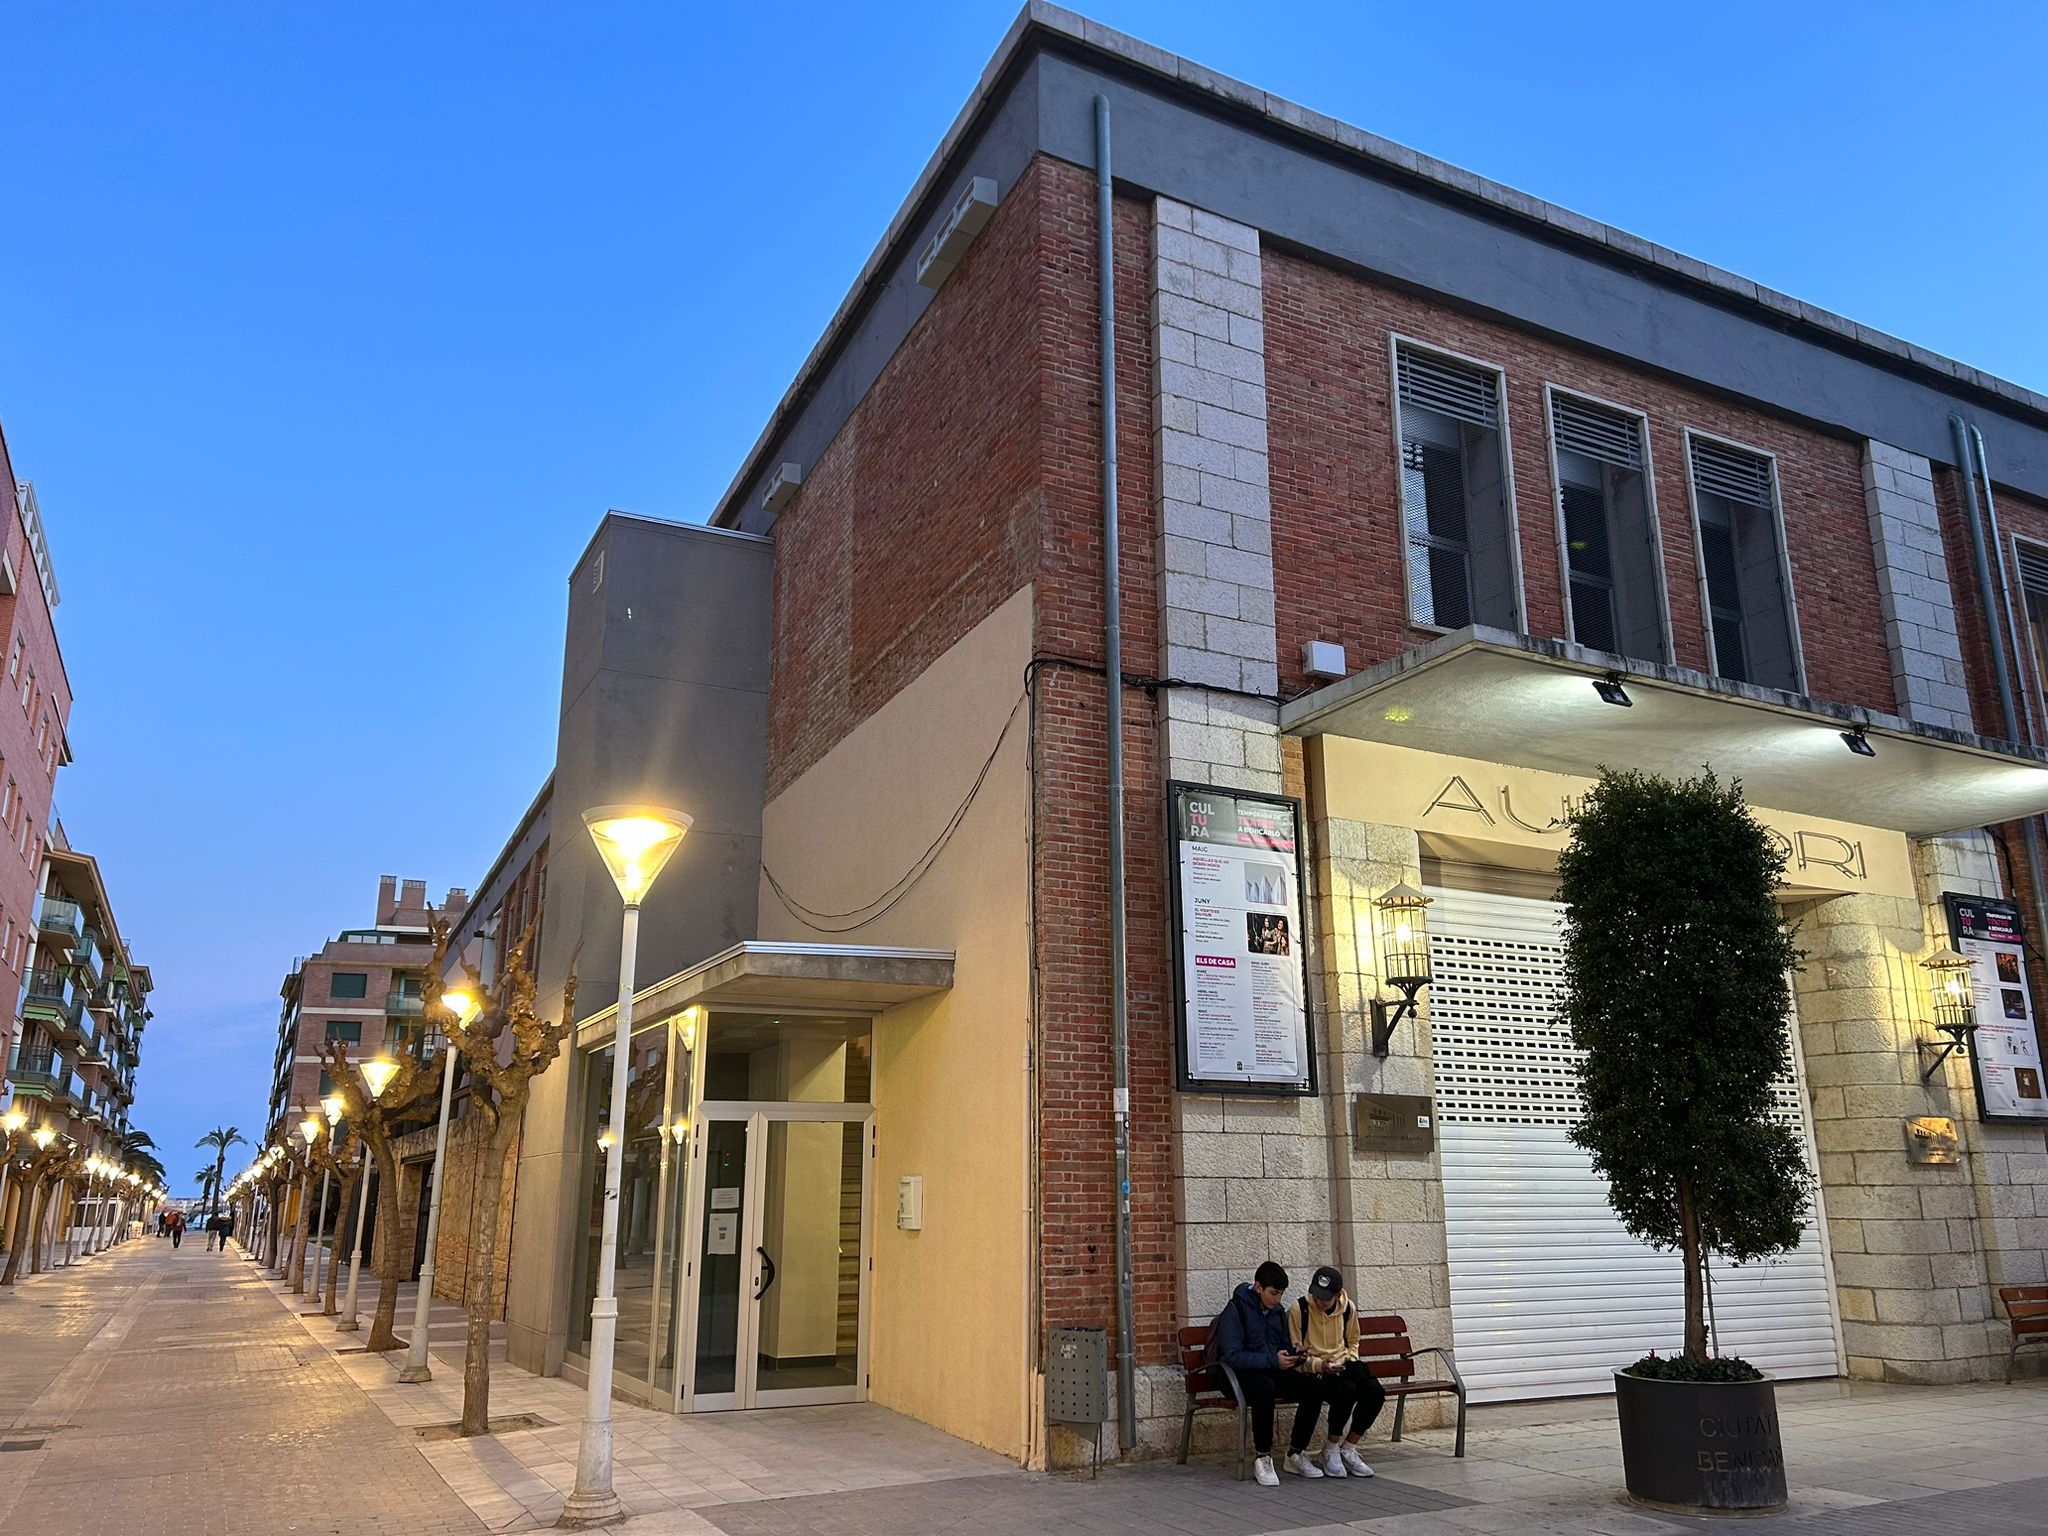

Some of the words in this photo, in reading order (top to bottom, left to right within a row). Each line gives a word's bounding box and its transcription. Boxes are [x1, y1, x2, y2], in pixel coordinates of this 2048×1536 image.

[1189, 801, 1215, 815] CUL
[1190, 813, 1208, 826] TU
[1191, 825, 1210, 838] RA
[1959, 908, 1975, 918] CUL
[1961, 917, 1972, 926] TU
[1962, 925, 1975, 936] RA
[1208, 957, 1217, 965] DE
[1217, 958, 1235, 967] CASA
